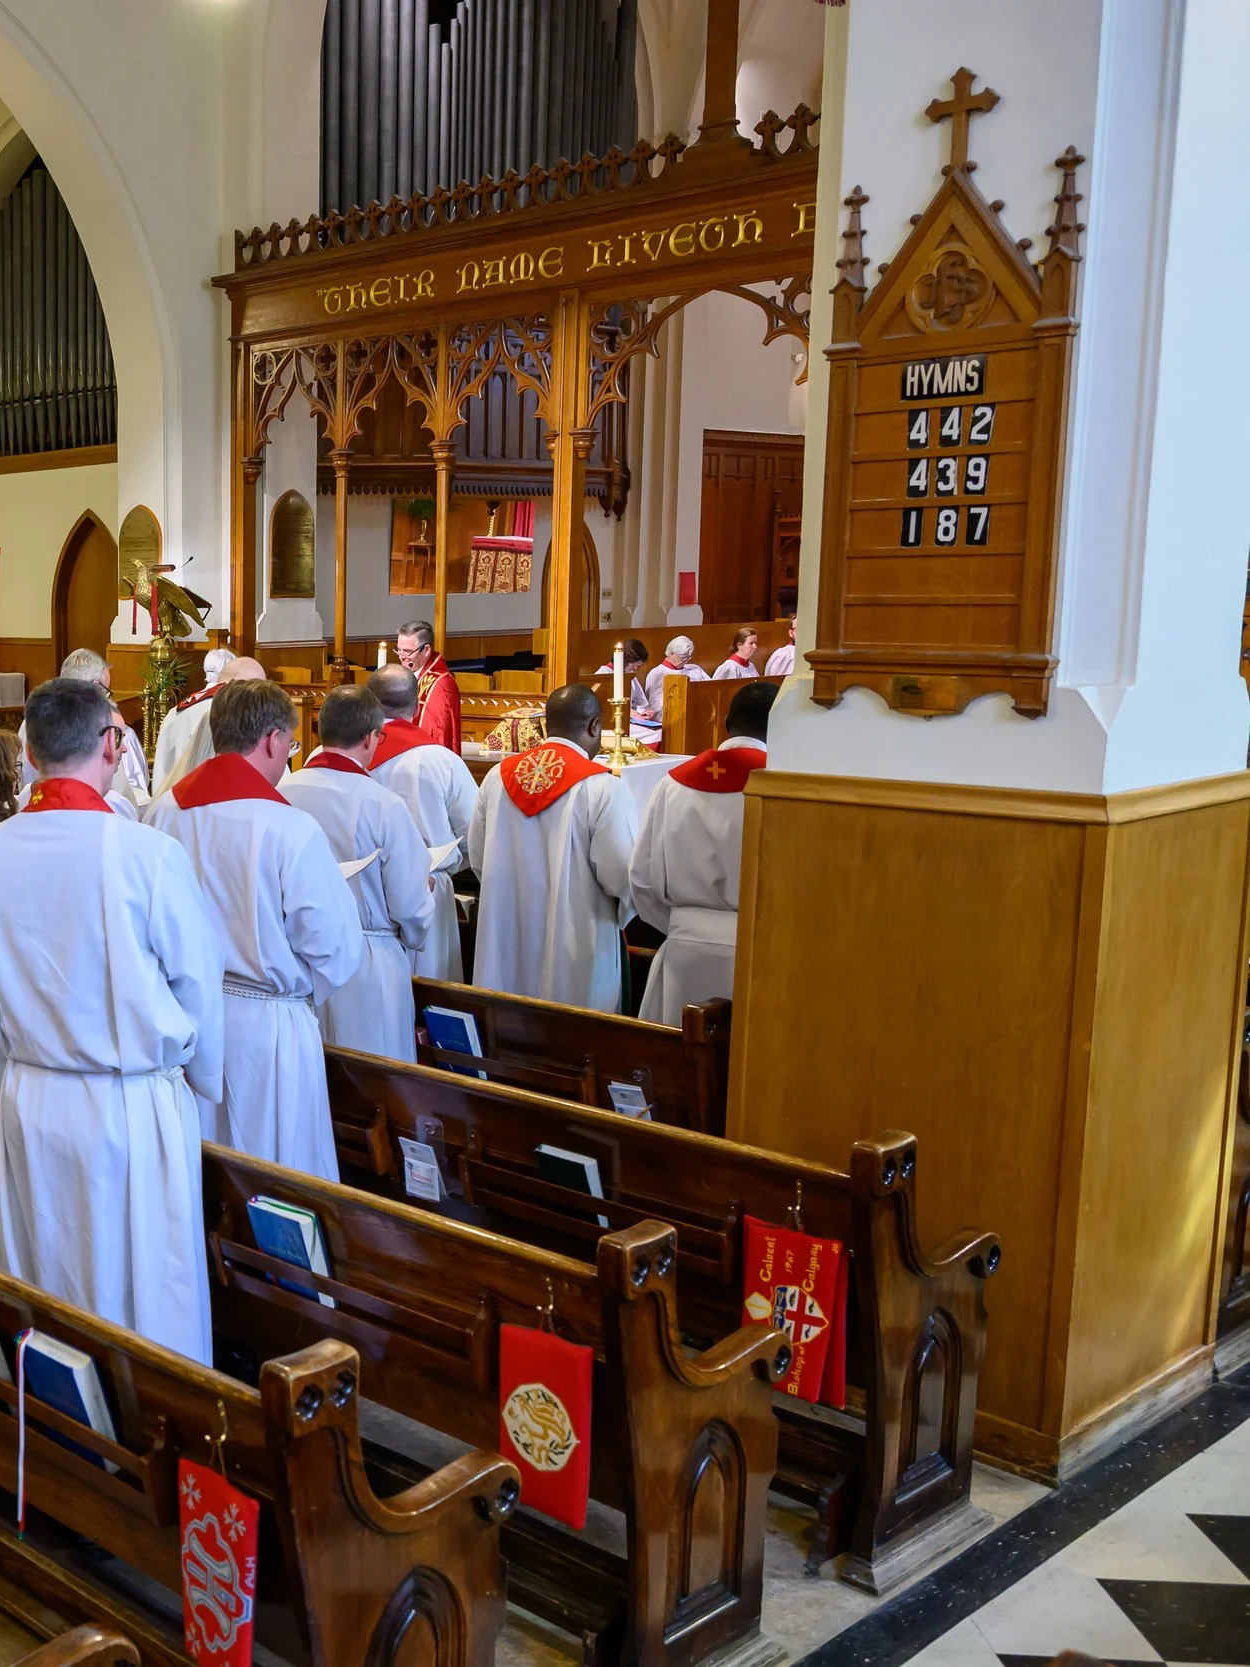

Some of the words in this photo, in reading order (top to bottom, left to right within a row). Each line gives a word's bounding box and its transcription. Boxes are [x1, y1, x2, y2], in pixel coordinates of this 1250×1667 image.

[456, 246, 564, 294] NAME
[906, 359, 981, 397] HYMNS
[909, 406, 993, 444] 442
[909, 457, 987, 491] 439
[908, 507, 989, 543] 187
[759, 1235, 777, 1282] Calvert
[784, 1249, 796, 1274] 1967
[787, 1356, 806, 1396] Bishop
[802, 1243, 823, 1293] Calgary
